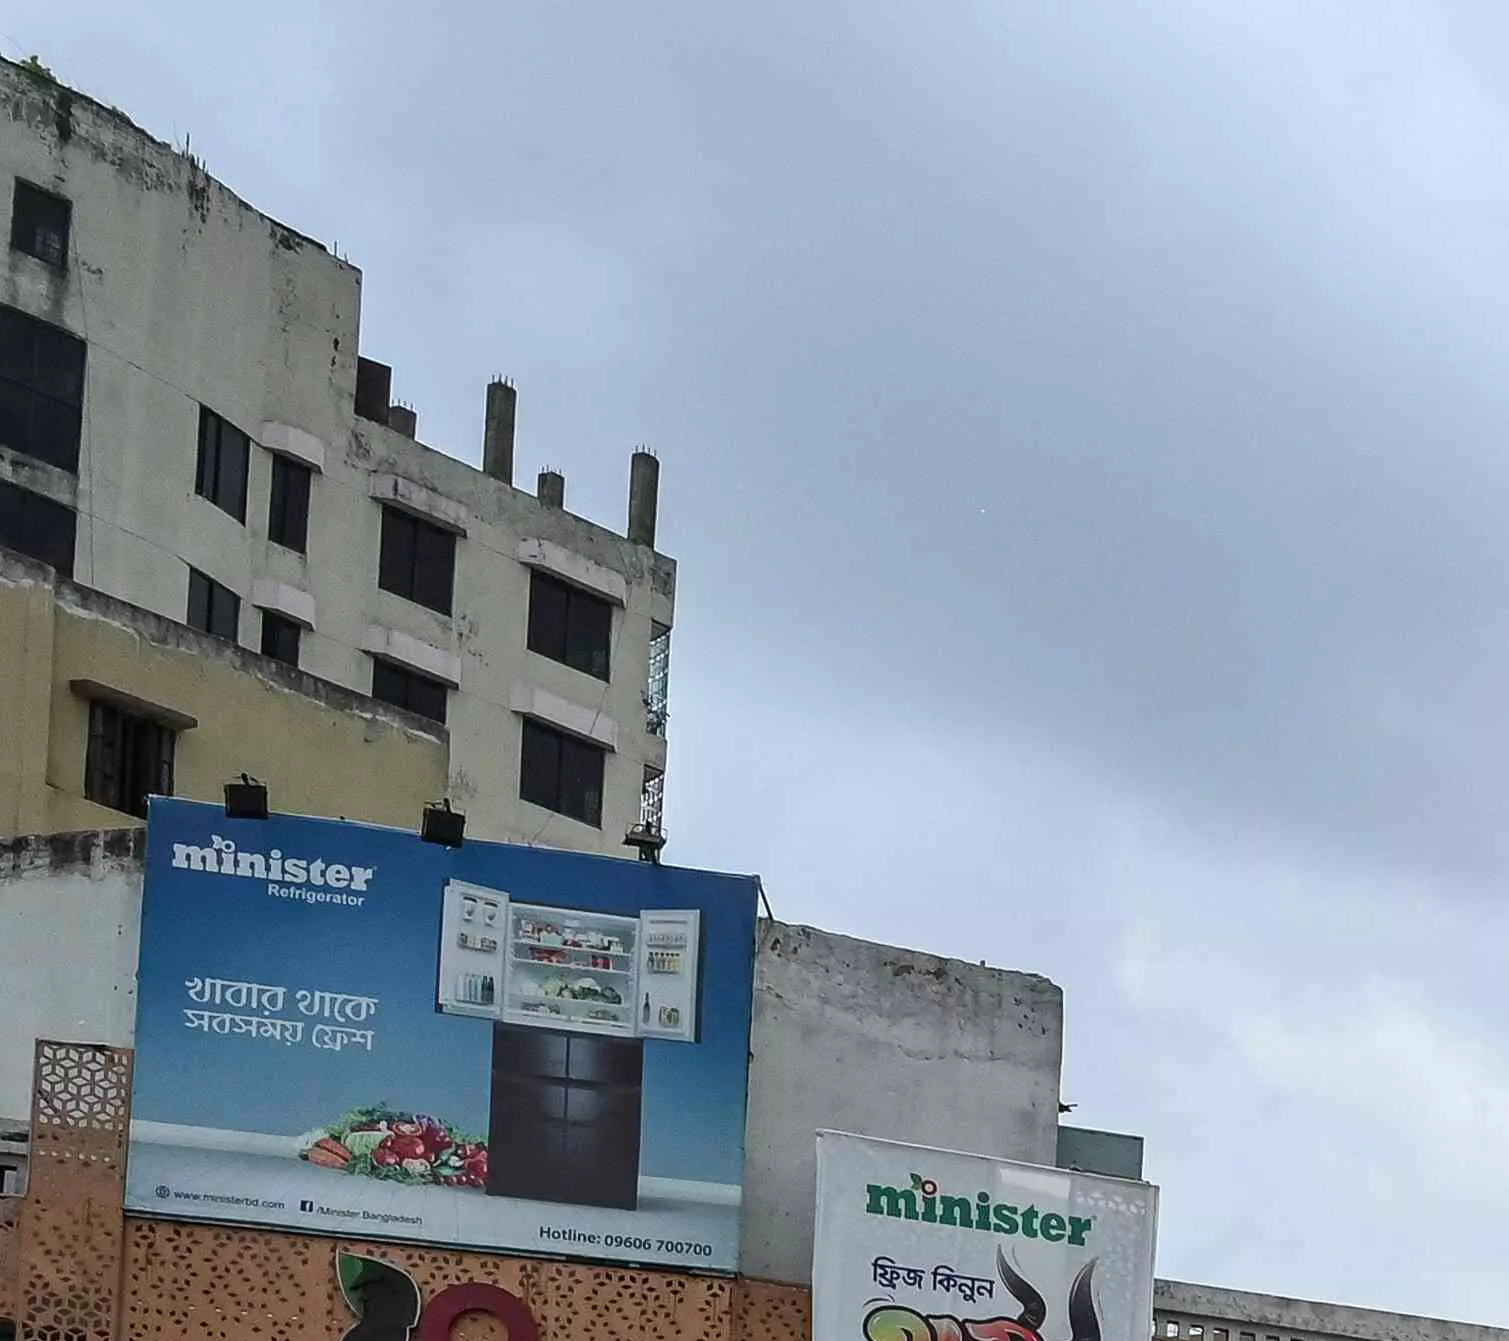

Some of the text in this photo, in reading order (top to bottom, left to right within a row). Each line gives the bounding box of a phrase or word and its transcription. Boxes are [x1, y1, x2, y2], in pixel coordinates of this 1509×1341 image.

[171, 835, 375, 892] minister
[267, 883, 365, 906] Refrigerator
[184, 977, 379, 1022] খাবার থাকে
[183, 1009, 375, 1050] সবসময় ফ্রেশ
[865, 1173, 1093, 1246] minister
[539, 1224, 714, 1258] Hotline: 09606 700700
[872, 1256, 996, 1304] ফ্রিজ কিনুন
